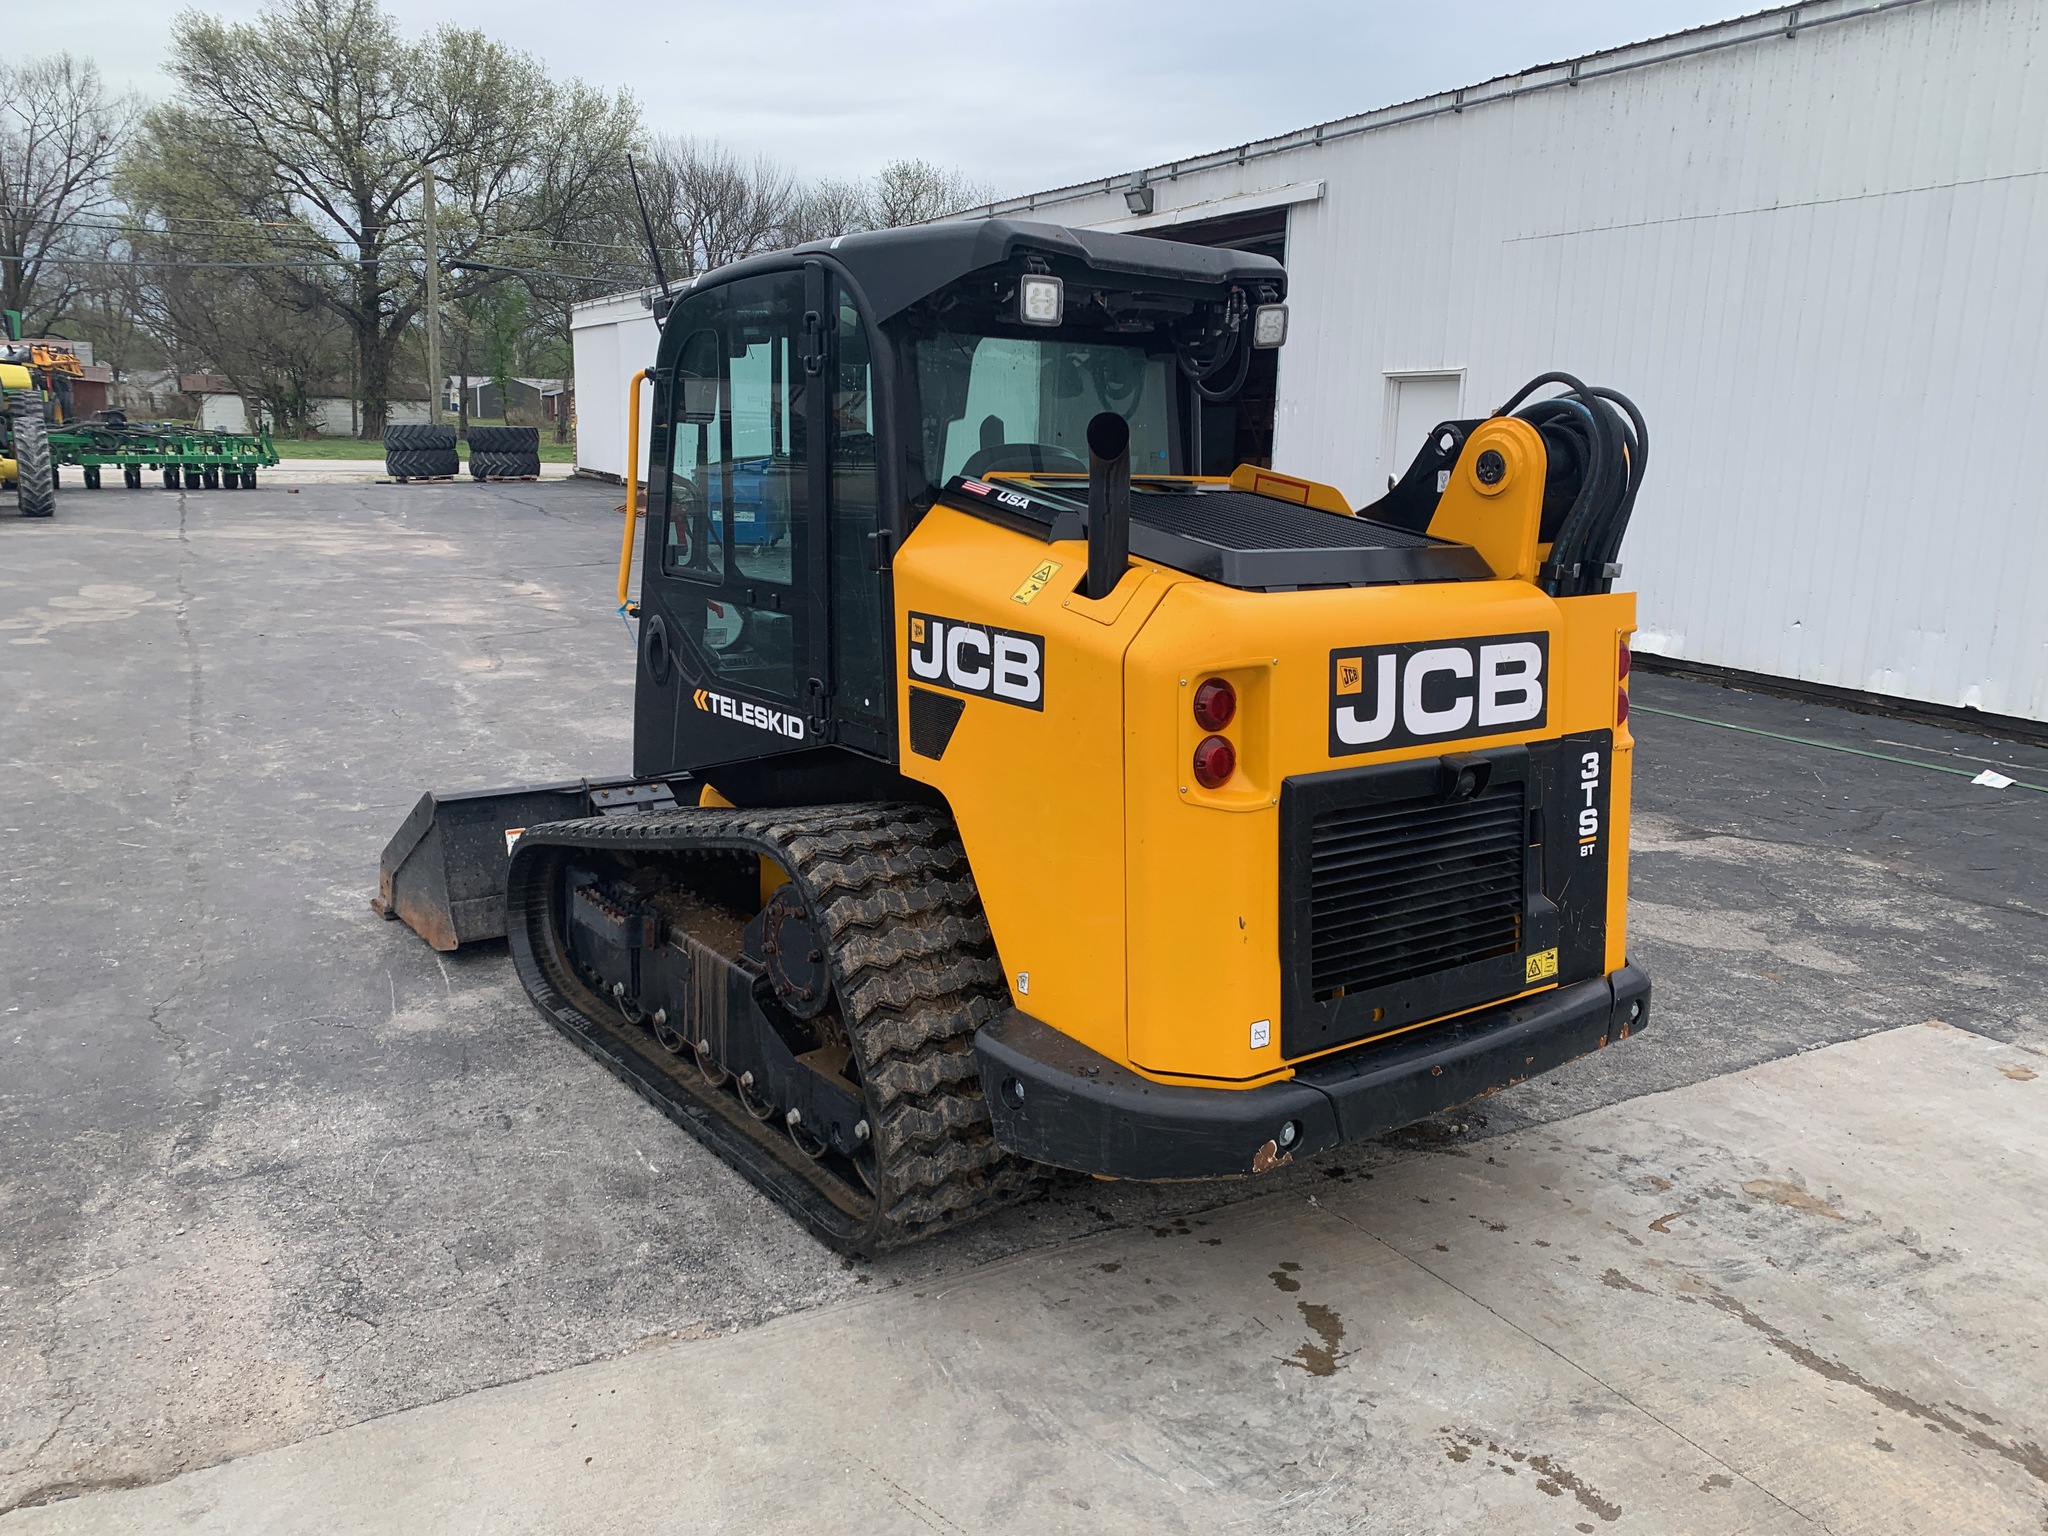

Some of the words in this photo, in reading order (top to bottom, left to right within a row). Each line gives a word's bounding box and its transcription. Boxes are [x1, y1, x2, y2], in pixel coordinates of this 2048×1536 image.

[996, 490, 1031, 510] USA
[911, 621, 1041, 703] JCB
[1343, 668, 1358, 685] JCB
[1336, 641, 1543, 745] JCB
[708, 691, 804, 740] TELESKID
[1580, 843, 1596, 857] 8T
